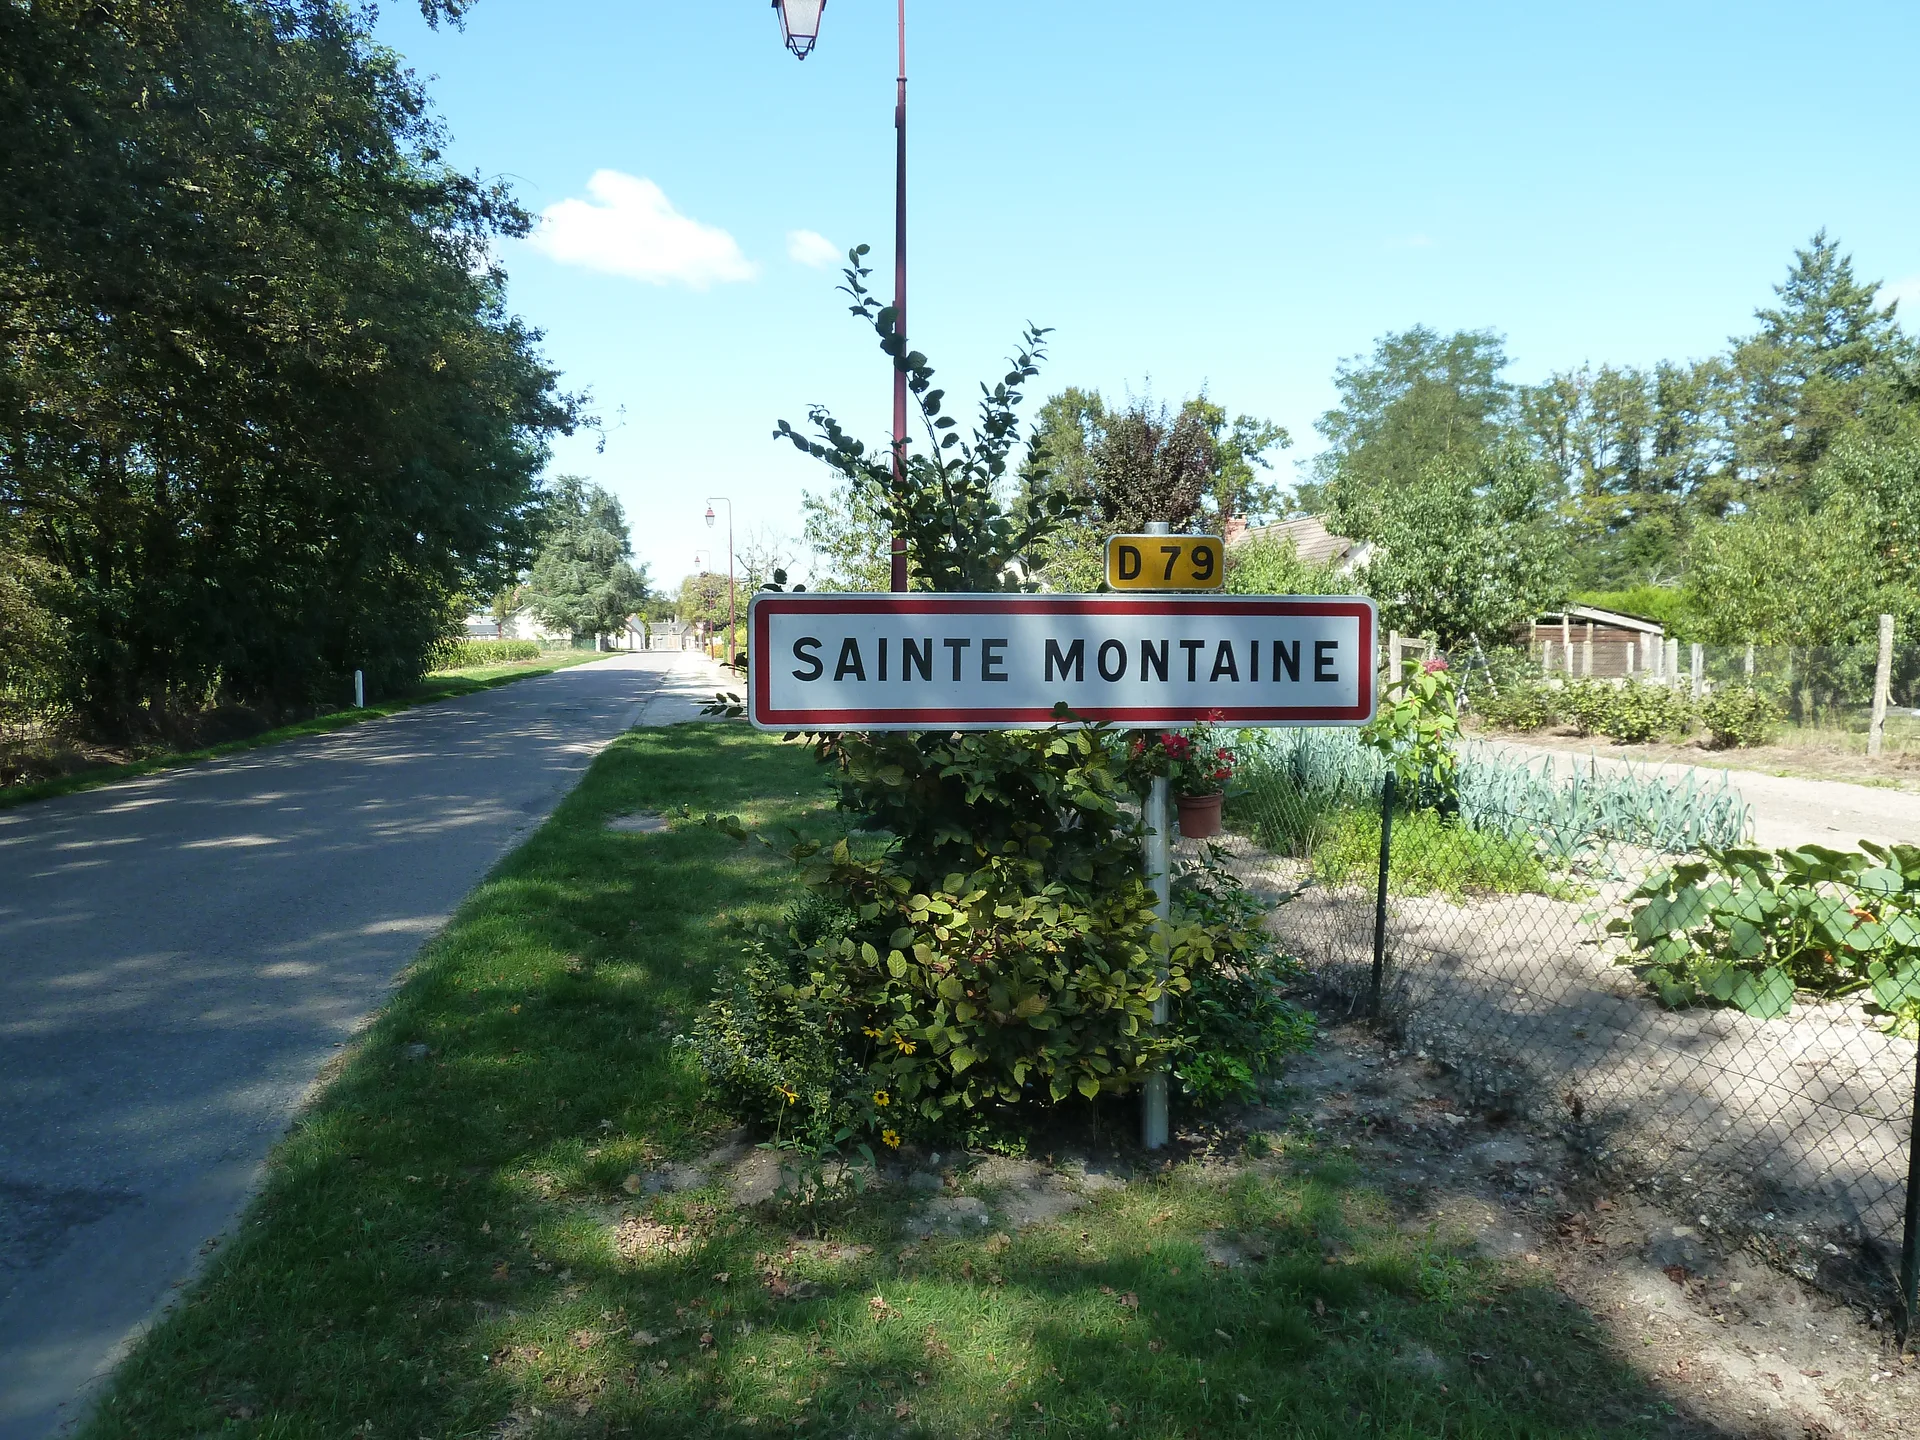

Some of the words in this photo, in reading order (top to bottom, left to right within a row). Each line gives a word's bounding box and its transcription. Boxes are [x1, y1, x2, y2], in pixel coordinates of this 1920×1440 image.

[1118, 545, 1142, 580] D
[1160, 545, 1214, 581] 79
[791, 636, 1009, 682] SAINTE
[1044, 638, 1340, 682] MONTAINE
